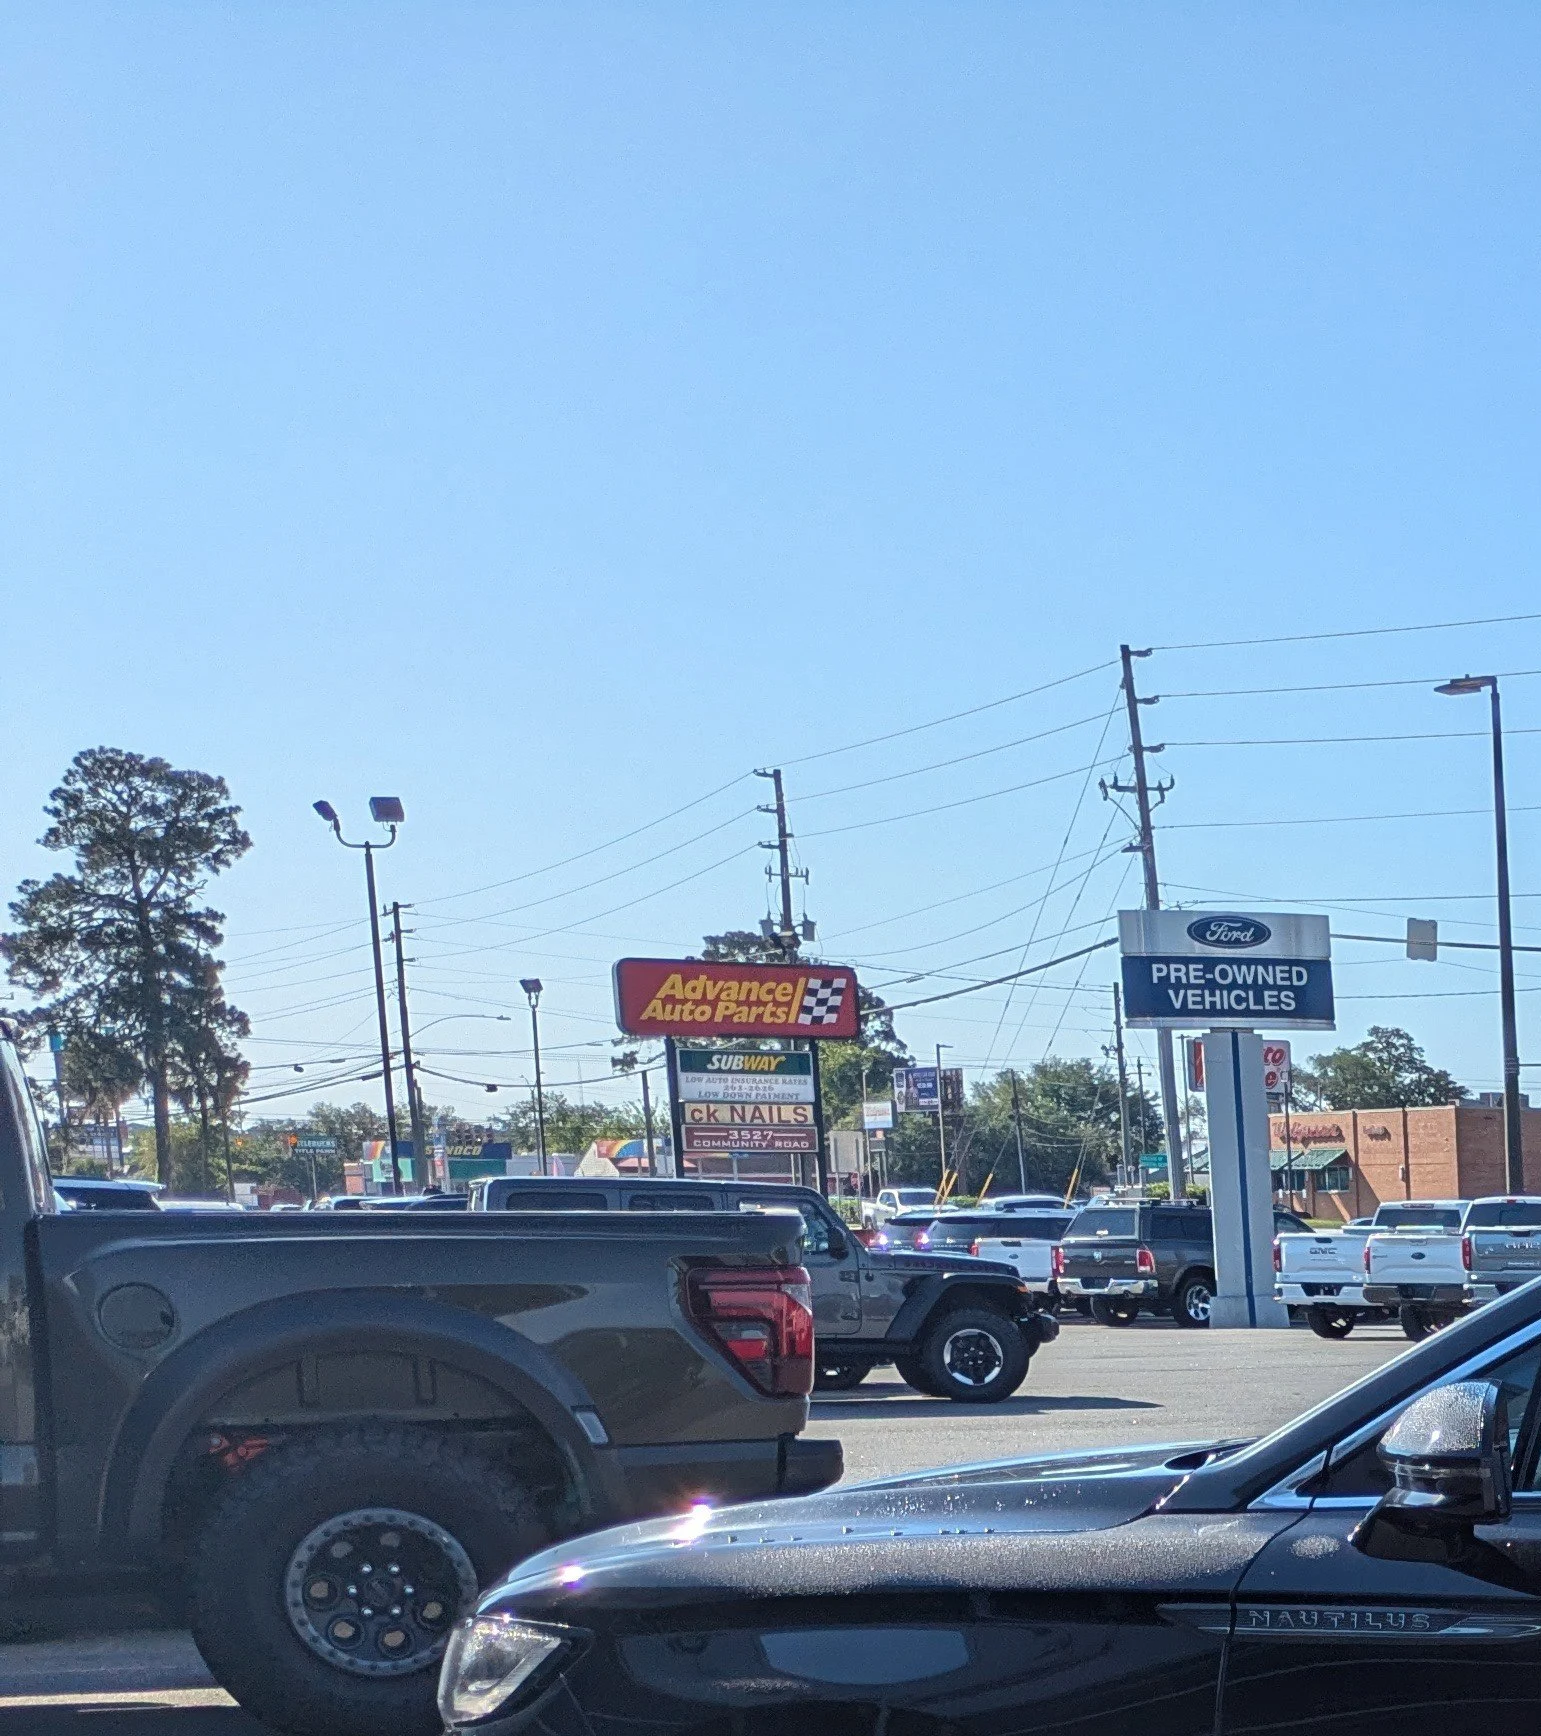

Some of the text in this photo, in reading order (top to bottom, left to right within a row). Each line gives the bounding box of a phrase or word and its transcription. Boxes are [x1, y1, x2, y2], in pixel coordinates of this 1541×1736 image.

[1205, 921, 1255, 942] Ford
[1151, 963, 1308, 986] PRE-OWNED
[655, 973, 793, 1002] Advance
[1168, 989, 1296, 1011] VEHICLES
[639, 999, 789, 1023] Auto Parts
[707, 1054, 786, 1071] SUBWAY
[685, 1076, 704, 1084] LOW
[731, 1077, 780, 1085] INSURANCE
[697, 1091, 800, 1100] LOW DOWN PAYMENT
[730, 1105, 809, 1124] NAILS
[693, 1140, 768, 1148] COMMUNITY
[728, 1130, 773, 1140] 3527
[425, 1145, 483, 1156] SNOCO
[1309, 1247, 1337, 1255] GMC
[1249, 1610, 1430, 1630] NAUTILUS
